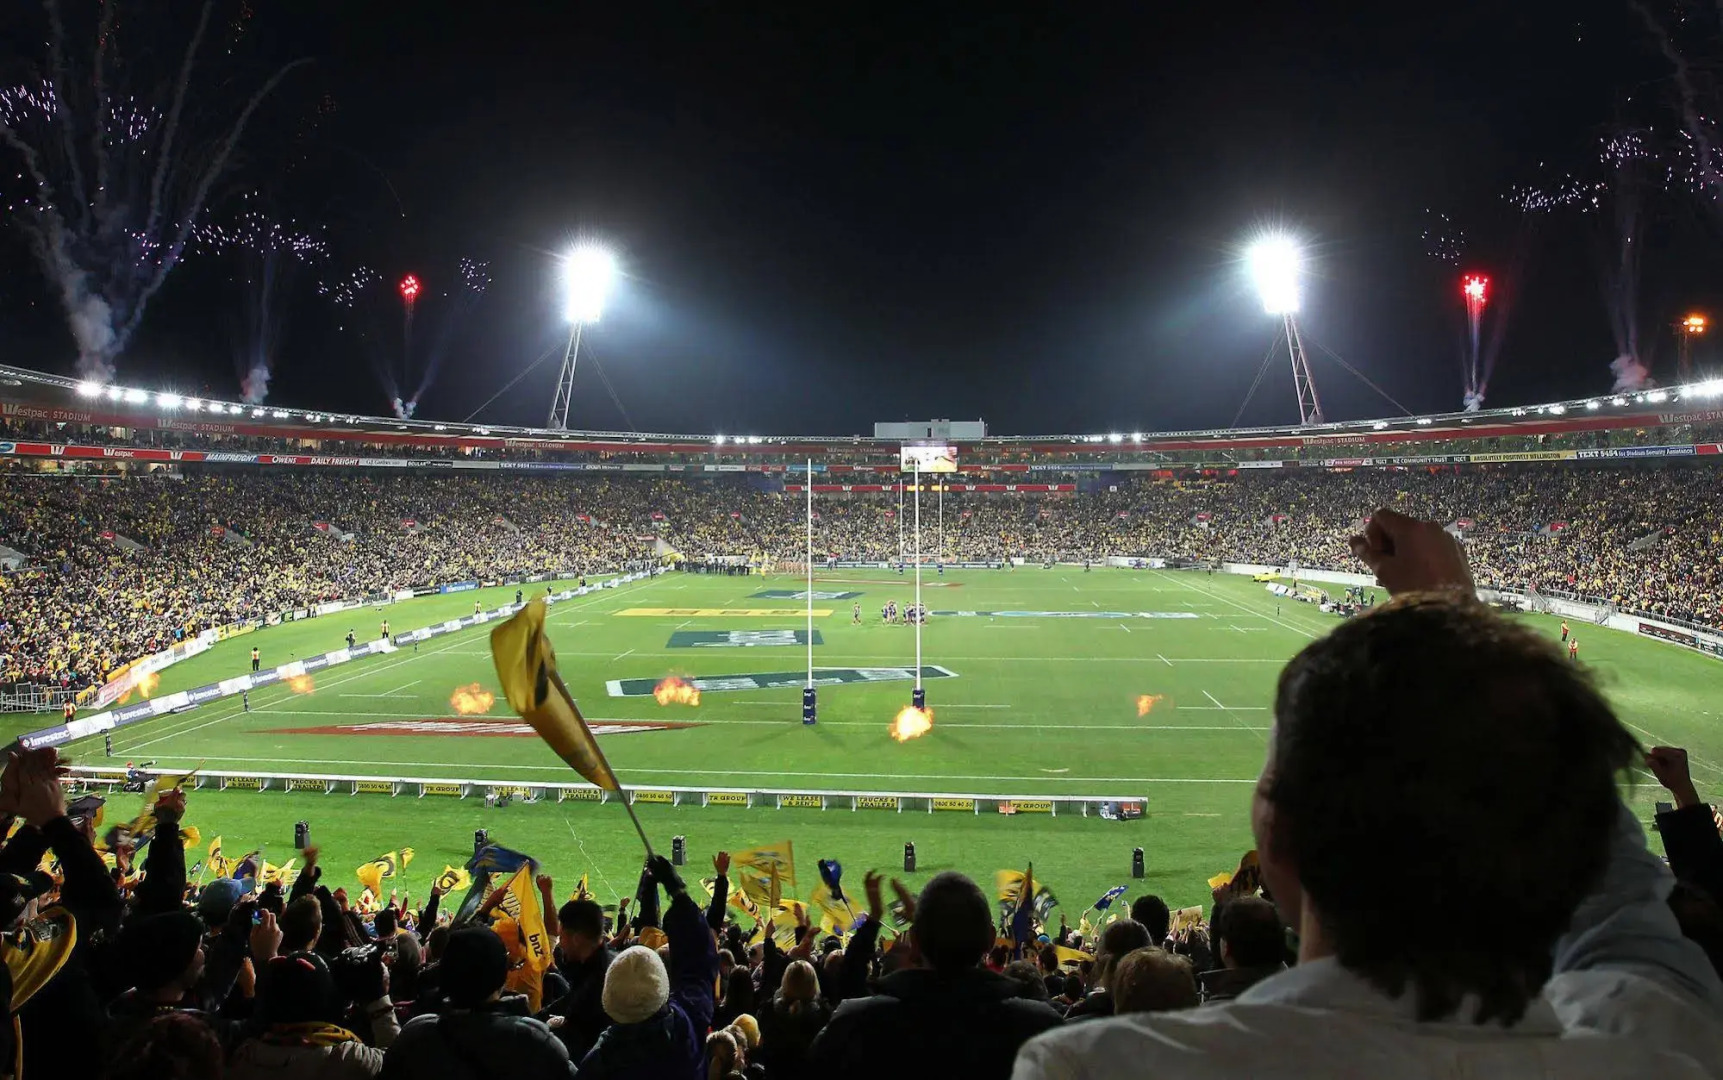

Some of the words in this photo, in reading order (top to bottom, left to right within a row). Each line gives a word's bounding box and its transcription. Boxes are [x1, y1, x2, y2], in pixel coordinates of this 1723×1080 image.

[2, 404, 48, 418] Westpac
[53, 411, 91, 422] STADIUM
[1658, 413, 1702, 423] Westpac
[157, 418, 197, 431] Westpac
[201, 425, 235, 433] STADIUM
[103, 448, 134, 458] Westpac
[206, 453, 257, 462] MAINFREIGHT
[311, 457, 331, 465] DAILY
[332, 458, 358, 466] FREIGHT
[120, 706, 152, 722] Investec
[29, 729, 70, 748] Investec
[529, 933, 543, 957] bnz
